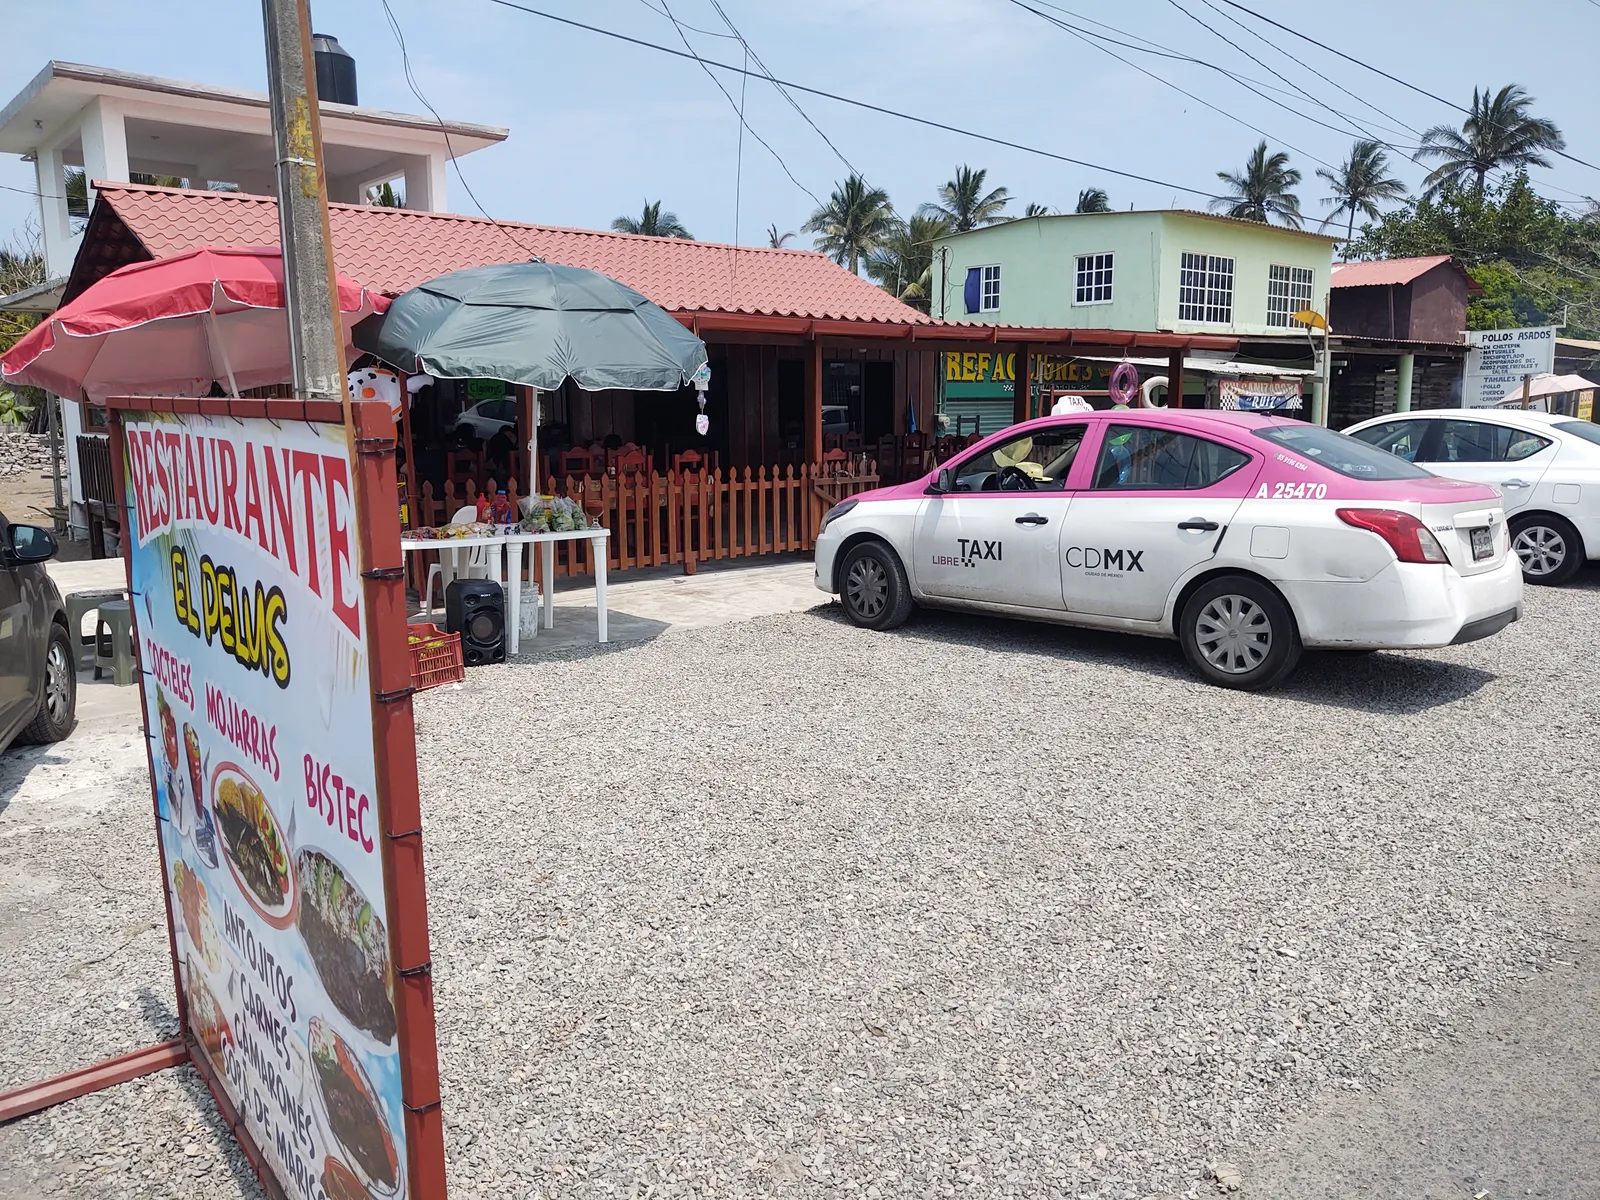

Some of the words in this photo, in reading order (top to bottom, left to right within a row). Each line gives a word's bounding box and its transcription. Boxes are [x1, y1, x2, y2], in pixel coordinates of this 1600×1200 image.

[1482, 333, 1513, 342] POLLOS
[1518, 331, 1551, 340] ASADOS
[1068, 397, 1083, 406] TAXI
[128, 429, 361, 641] RESTAURANTE
[1255, 482, 1267, 499] A
[1272, 482, 1327, 500] 25470
[932, 555, 959, 566] LIBRE
[957, 538, 1002, 561] TAXI
[1066, 546, 1144, 572] CDMX
[171, 545, 201, 638] EL
[200, 554, 290, 689] PELUS
[147, 638, 195, 711] COCTELES
[205, 682, 280, 782] MOJARRAS
[303, 753, 374, 854] BISTEC
[224, 900, 297, 1023] ANTOJITOS
[240, 973, 291, 1071] CARNES
[222, 1037, 252, 1110] SOPA
[253, 1087, 272, 1141] DE
[275, 1122, 326, 1200] MARIS
[234, 1012, 316, 1160] CAMARONES
